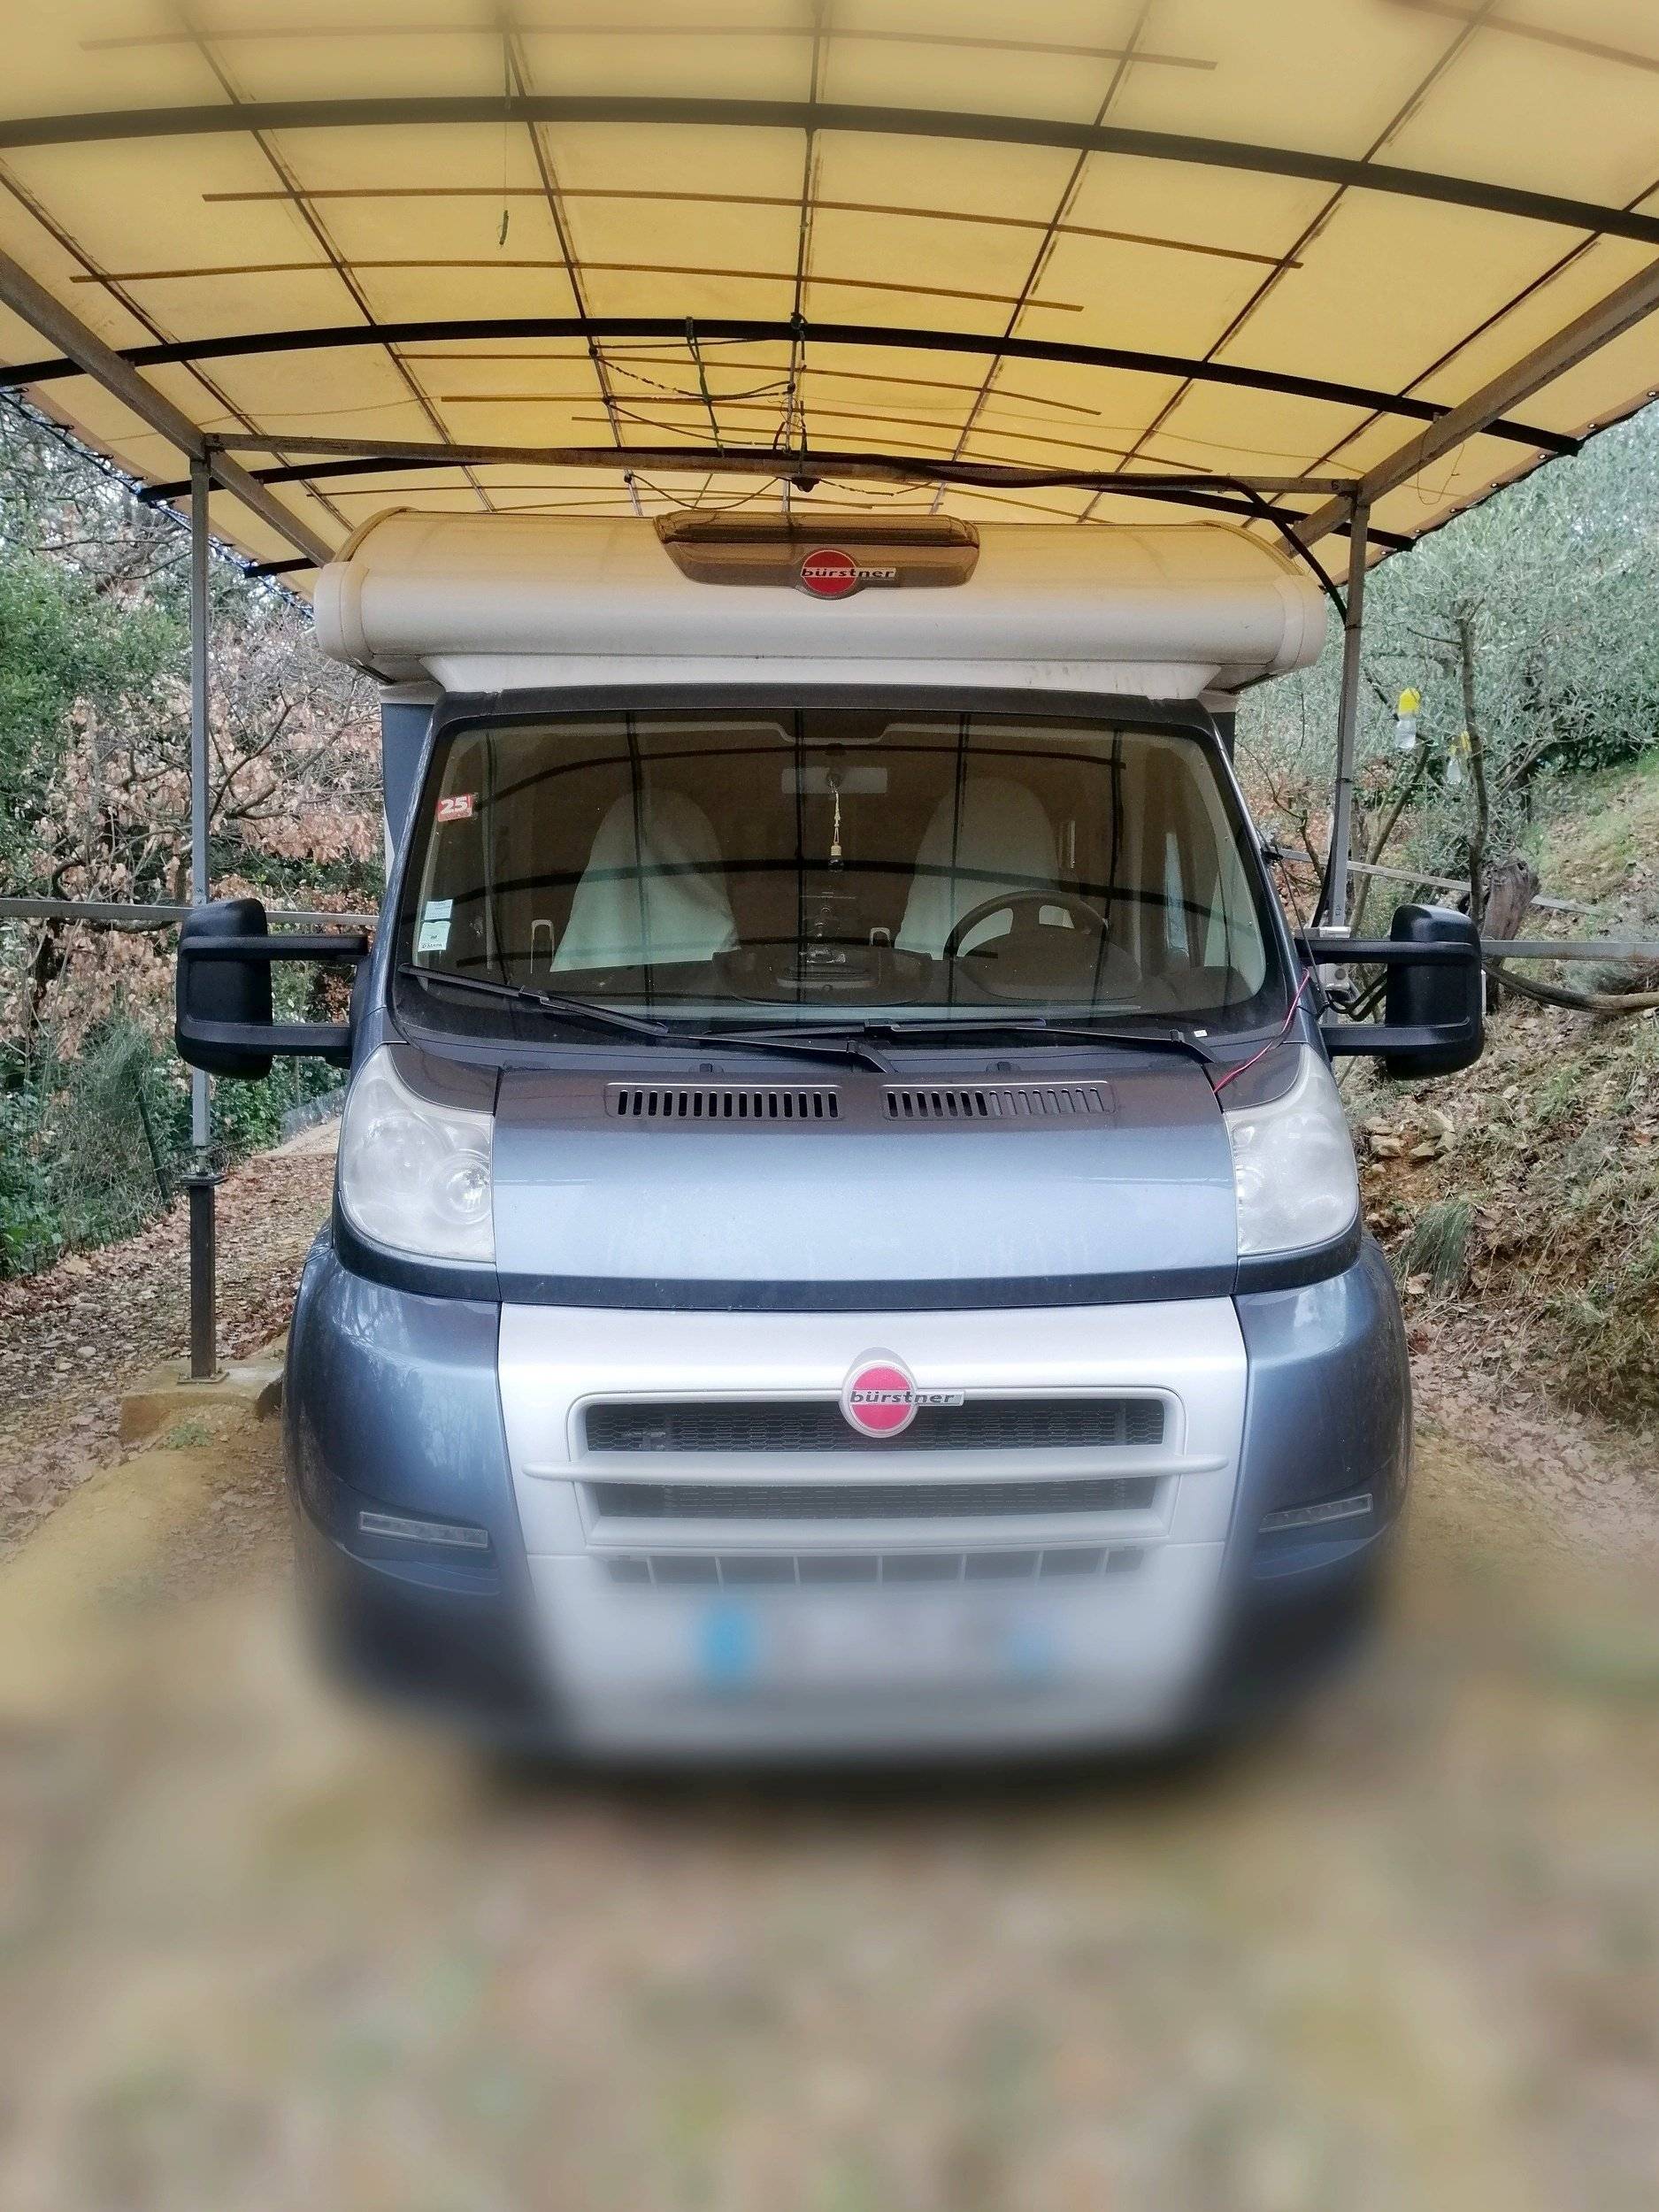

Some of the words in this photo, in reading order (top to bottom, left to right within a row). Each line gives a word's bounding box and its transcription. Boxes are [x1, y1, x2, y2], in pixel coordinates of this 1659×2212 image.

[802, 568, 895, 578] bürstner
[440, 795, 468, 815] 25
[849, 1390, 955, 1403] bürstner
